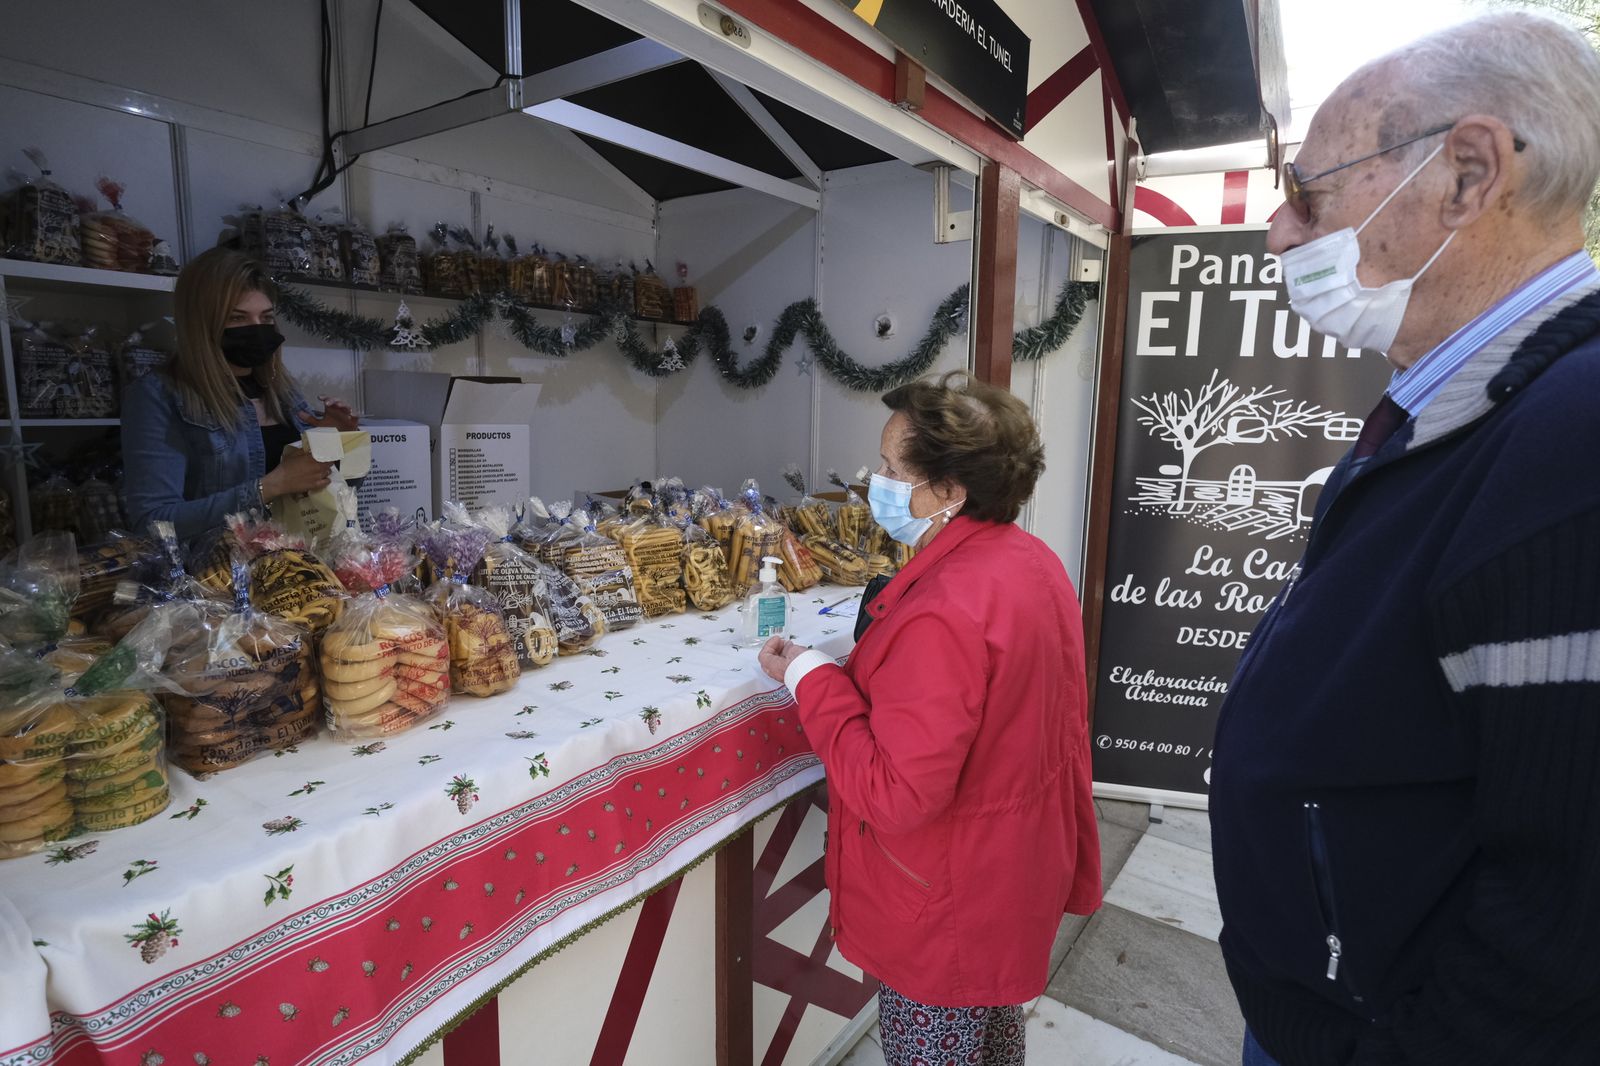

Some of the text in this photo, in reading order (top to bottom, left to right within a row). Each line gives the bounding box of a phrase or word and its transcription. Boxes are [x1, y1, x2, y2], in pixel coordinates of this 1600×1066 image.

[977, 25, 988, 50] EL
[989, 36, 1013, 73] TUNEL
[1136, 291, 1204, 356] El
[371, 435, 407, 443] DUCTOS
[466, 432, 512, 440] PRODUCTOS
[1185, 544, 1233, 577] La
[1110, 574, 1147, 605] de
[1154, 577, 1203, 609] las
[1176, 626, 1251, 650] DESDE
[1109, 666, 1229, 694] Elaboración
[1125, 685, 1209, 708] Artesana
[34, 728, 96, 745] ROSCOS
[98, 724, 115, 738] DE
[278, 725, 289, 739] El
[1114, 738, 1138, 750] 950
[1139, 741, 1155, 752] 64
[1156, 743, 1173, 754] 00
[1174, 744, 1191, 756] 80
[133, 803, 147, 815] El
